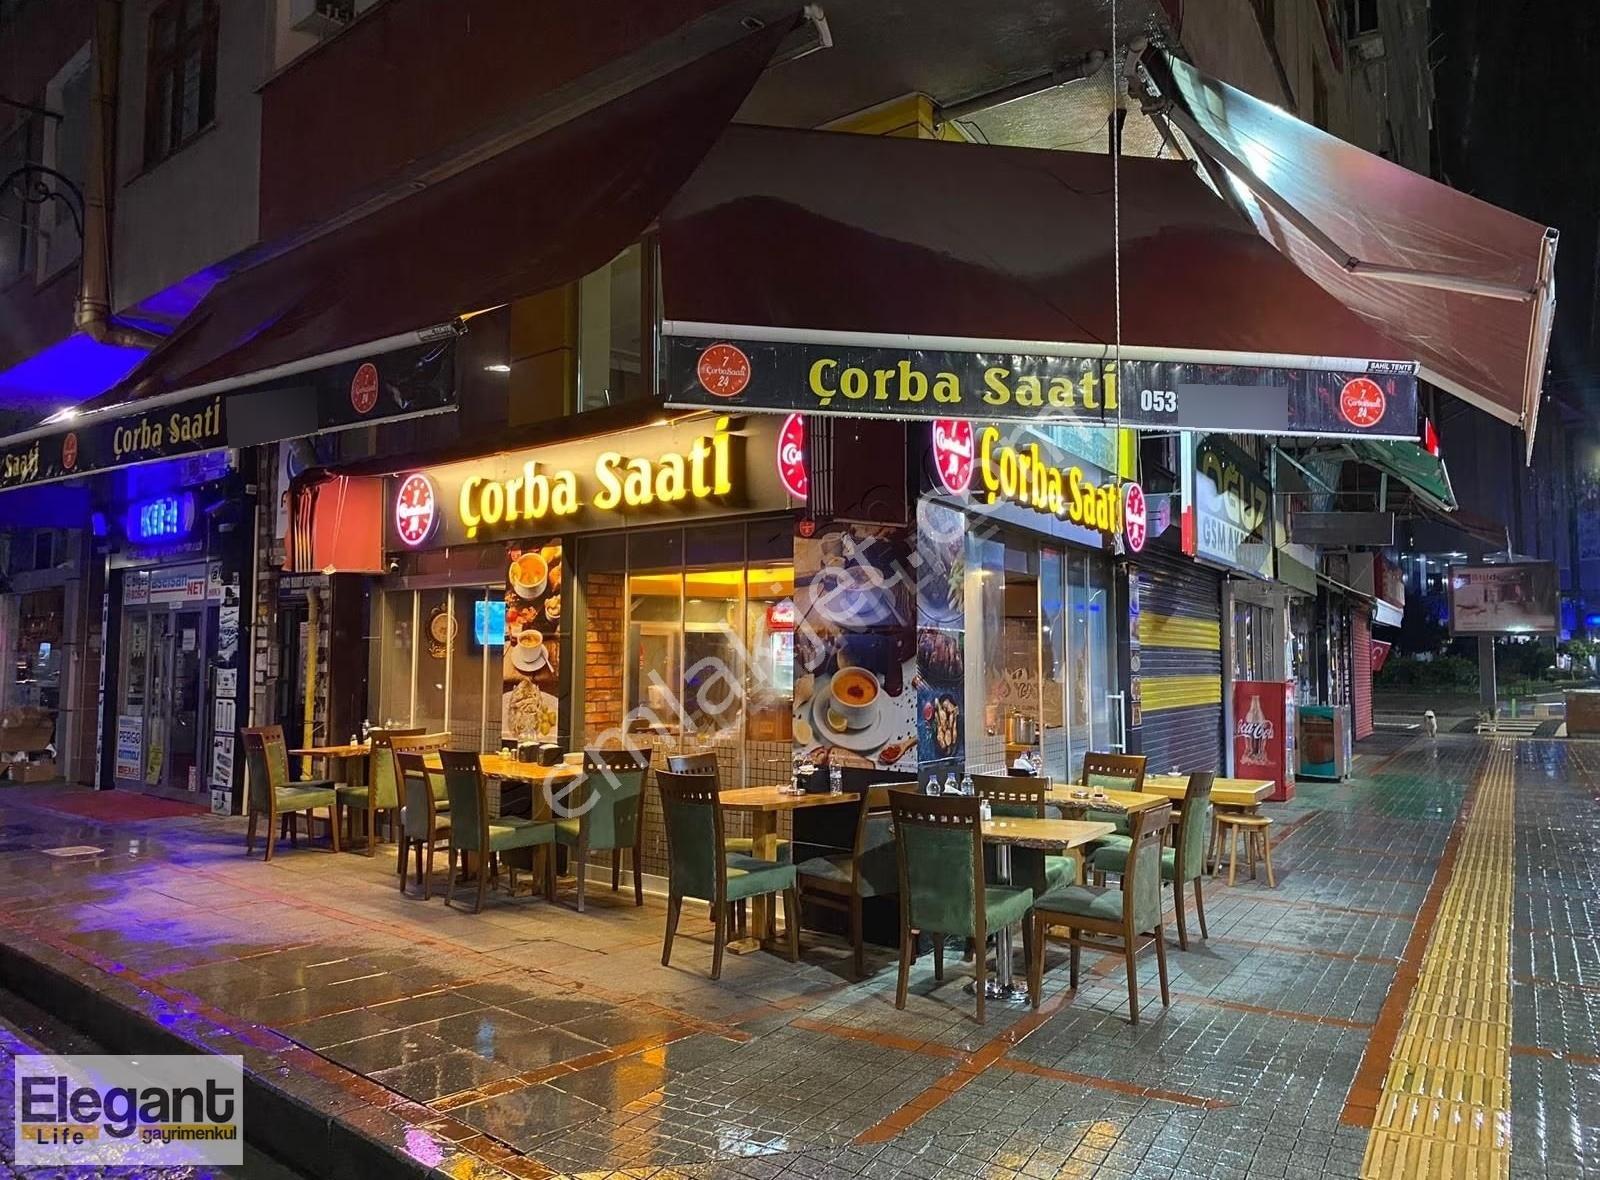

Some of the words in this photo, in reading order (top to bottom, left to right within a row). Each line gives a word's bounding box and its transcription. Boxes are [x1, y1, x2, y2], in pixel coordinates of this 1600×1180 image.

[717, 375, 729, 387] 24
[808, 358, 962, 407] Çorba
[113, 417, 163, 462] Çorba
[981, 425, 1063, 516] Çorba
[458, 459, 580, 540] Çorba
